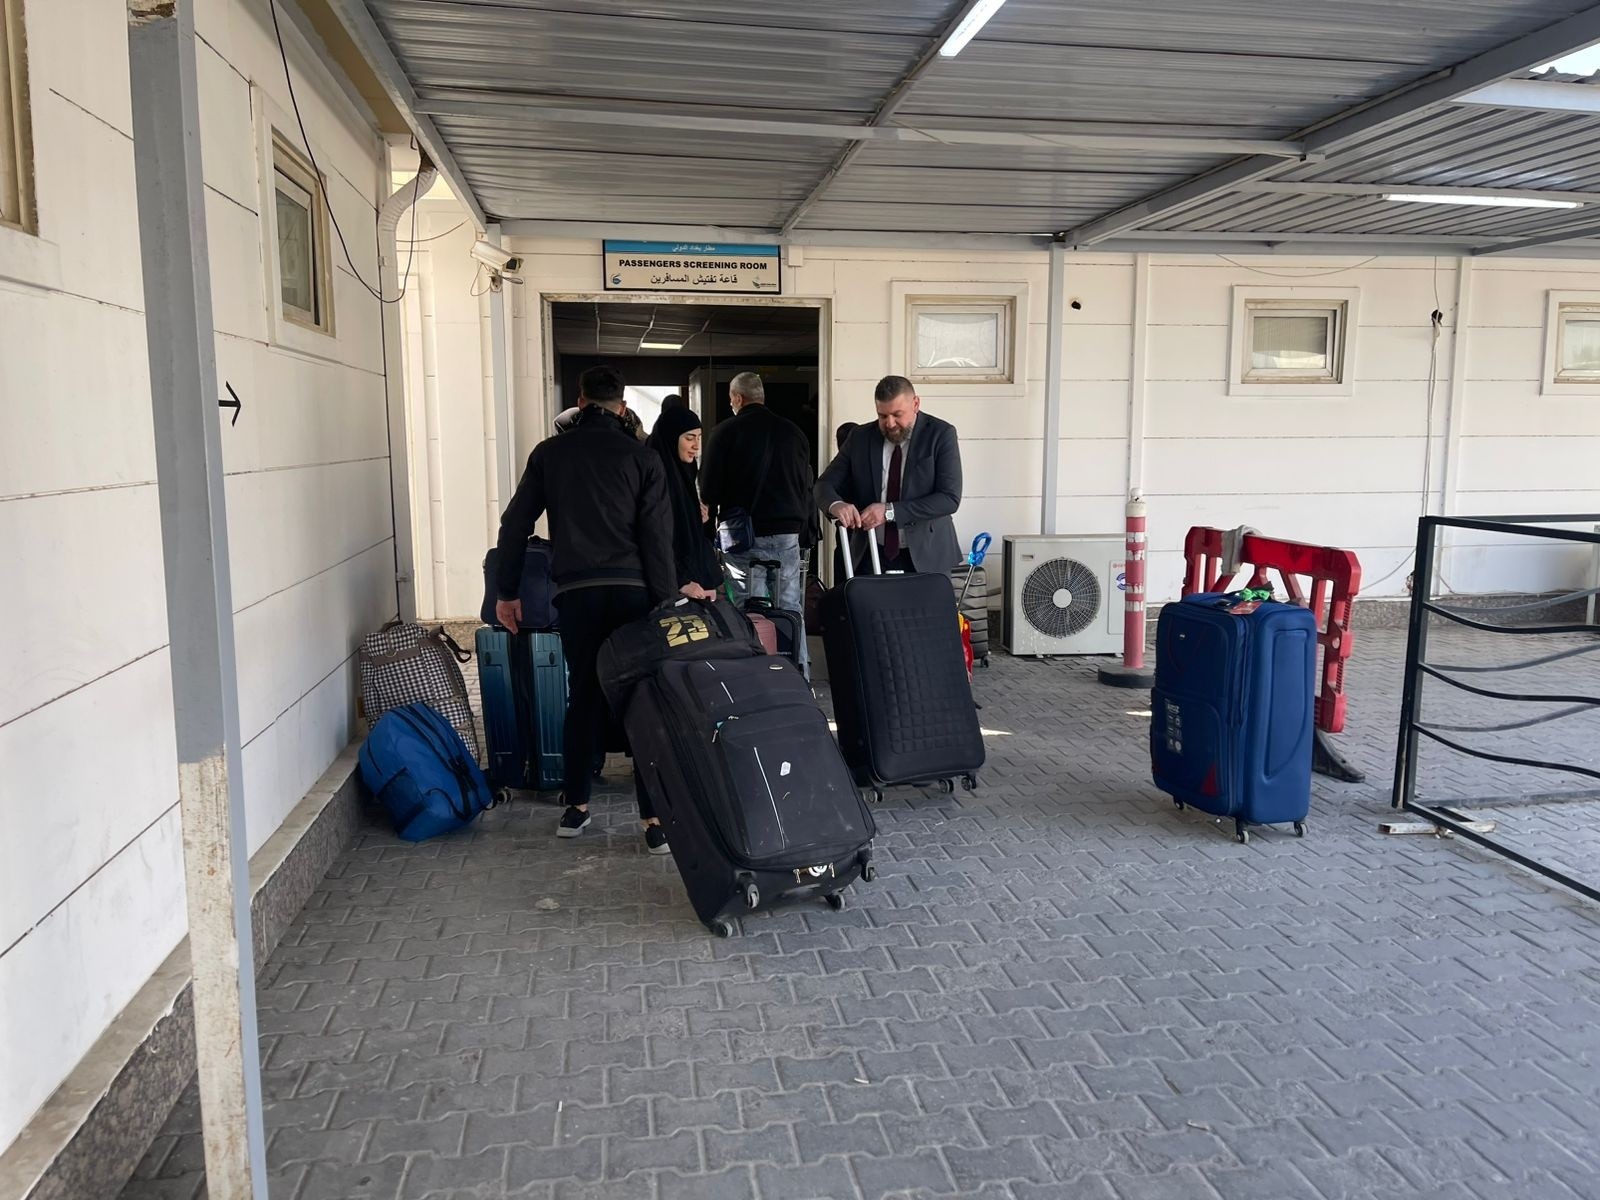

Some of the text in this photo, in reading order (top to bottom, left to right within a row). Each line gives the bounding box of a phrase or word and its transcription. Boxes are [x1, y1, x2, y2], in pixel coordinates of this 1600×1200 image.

[619, 259, 768, 270] PASSENGERS SCREENING ROOM
[650, 272, 738, 285] قاعة تفتيش المسافرين
[659, 614, 709, 648] 23
